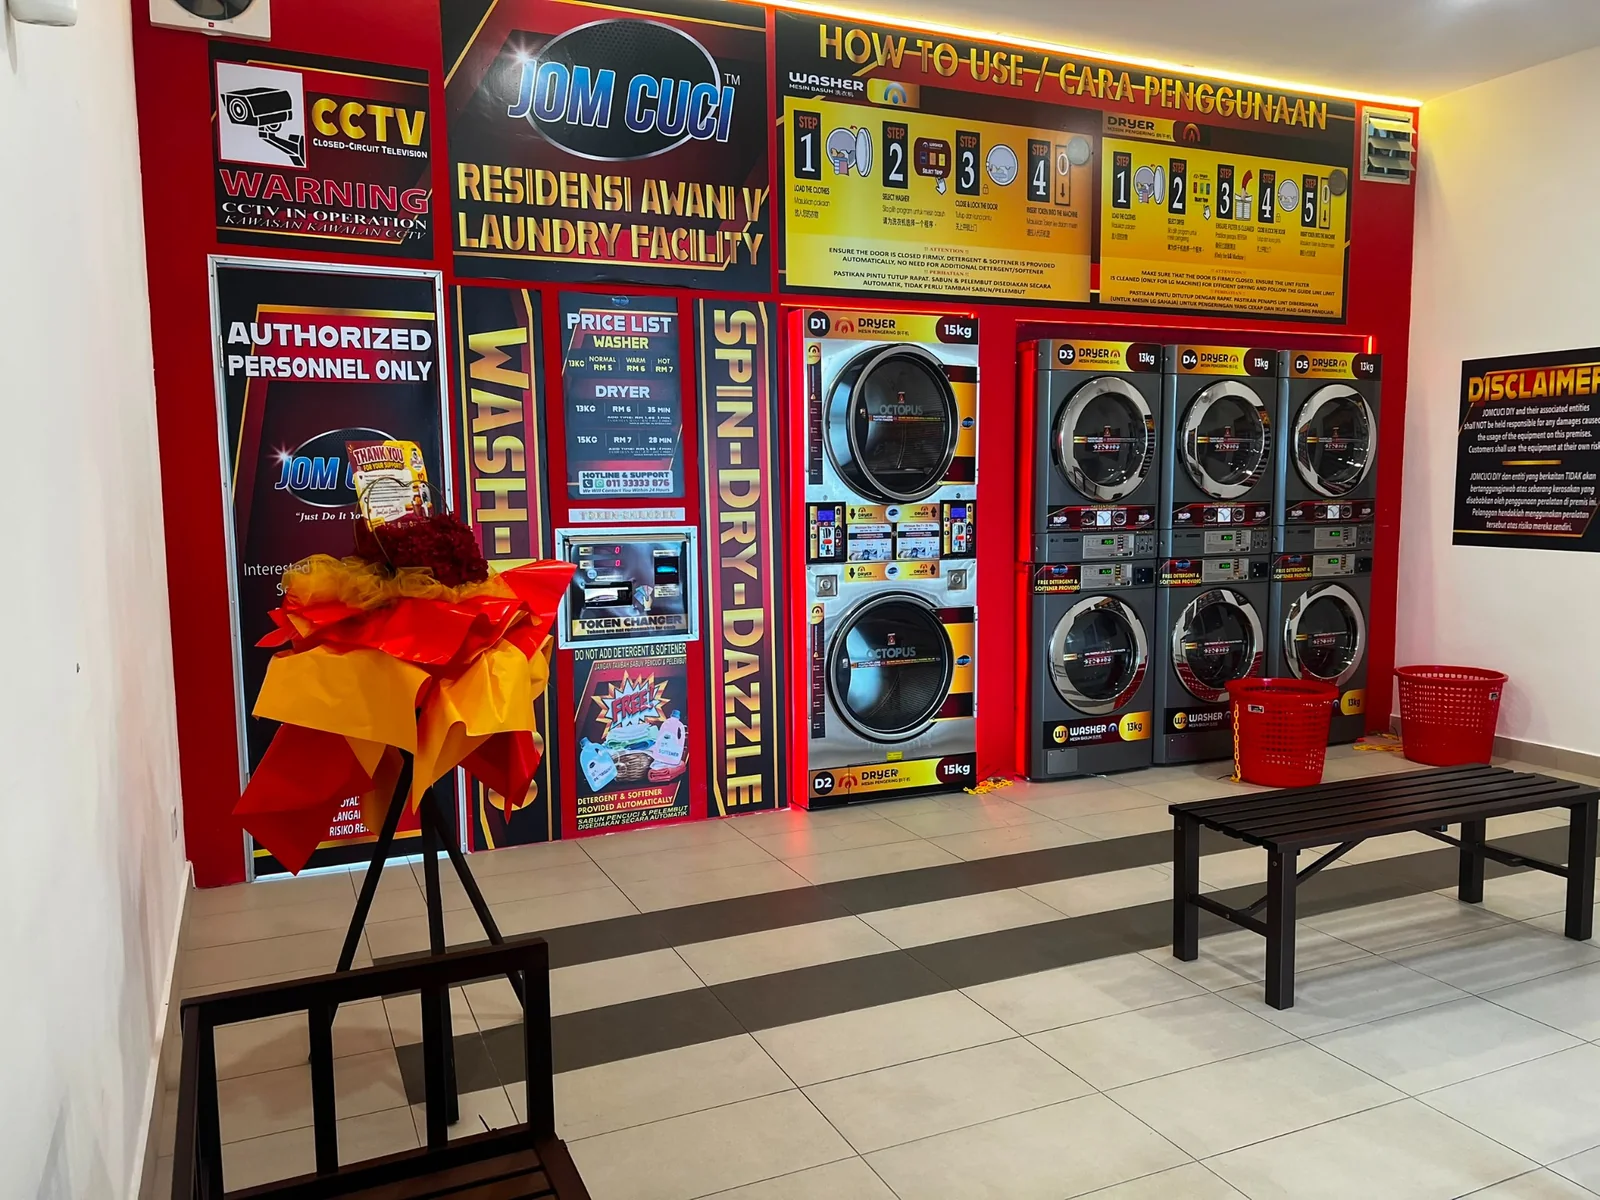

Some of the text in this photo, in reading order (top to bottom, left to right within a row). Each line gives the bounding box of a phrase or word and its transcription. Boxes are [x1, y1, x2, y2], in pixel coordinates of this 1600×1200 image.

[724, 73, 741, 86] TM
[789, 71, 864, 91] WASHER
[820, 24, 1327, 130] HOW TO USE / CARA PENGGUNAAN
[789, 83, 810, 91] MESIN
[508, 60, 735, 142] JOM CUCI
[312, 98, 426, 145] CCTV
[799, 116, 818, 130] STEP
[1107, 115, 1155, 131] DRYER
[887, 126, 905, 140] STEP
[960, 135, 977, 149] STEP
[801, 133, 816, 173] 1
[1032, 143, 1049, 156] STEP
[889, 142, 904, 182] 2
[1116, 155, 1130, 168] STEP
[1172, 162, 1184, 173] STEP
[961, 151, 975, 189] 3
[1220, 168, 1232, 179] STEP
[1033, 159, 1047, 196] 4
[1262, 173, 1274, 184] STEP
[1305, 178, 1317, 189] STEP
[219, 169, 429, 214] WARNING
[457, 162, 762, 222] RESIDENSI AWANI V
[1117, 170, 1127, 204] 1
[1172, 176, 1183, 210] 2
[1220, 182, 1230, 214] 3
[1261, 187, 1272, 218] 4
[1304, 191, 1314, 223] 5
[222, 202, 427, 230] CCTV IN OPERATION
[225, 215, 426, 240] KAWASAN KAWALAN CCTV
[458, 212, 764, 266] LAUNDRY FACILITY
[842, 256, 896, 266] AUTOMATICALLY,
[940, 263, 978, 271] ADDITIONAL
[979, 265, 1044, 275] DETERGENT/SOFTENER
[989, 258, 1018, 266] SOFTENER
[1027, 261, 1056, 269] PROVIDED
[567, 313, 671, 333] PRICE LIST
[810, 317, 826, 329] D1
[858, 317, 896, 329] DRYER
[227, 321, 432, 351] AUTHORIZED
[944, 324, 972, 338] 15kg
[593, 335, 649, 349] WASHER
[1059, 349, 1074, 359] D3
[1079, 348, 1109, 358] DRYER
[1138, 352, 1155, 365] 13kg
[1182, 354, 1197, 364] D4
[1201, 353, 1228, 363] DRYER
[228, 355, 432, 381] PERSONNEL ONLY
[1254, 358, 1269, 370] 13kg
[1296, 360, 1309, 370] D5
[1312, 358, 1338, 368] DRYER
[1360, 362, 1374, 373] 13kg
[595, 385, 650, 398] DRYER
[576, 405, 596, 413] 13KG
[879, 404, 923, 416] OCTOPUS
[1506, 407, 1515, 416] DIY
[1516, 407, 1526, 415] and
[1527, 405, 1539, 414] their
[1540, 404, 1568, 414] associated
[1569, 403, 1590, 412] entities
[577, 436, 598, 444] 15KG
[613, 436, 626, 444] RM
[627, 436, 632, 444] 7
[353, 446, 404, 465] THANK YOU
[275, 456, 340, 491] JOM
[630, 471, 669, 479] SUPPORT
[623, 479, 650, 487] 33333
[652, 479, 670, 487] 876
[322, 512, 335, 521] Do
[338, 512, 347, 521] It
[713, 309, 763, 806] SPIN-DRY-DAZZLE
[579, 615, 682, 629] TOKEN CHANGER
[575, 643, 687, 661] DO NOT ADD DETERGENT & SOFTENER
[866, 646, 917, 659] OCTOPUS
[612, 686, 655, 722] FREE!
[1347, 698, 1361, 708] 13kg
[1174, 716, 1187, 725] W2
[1188, 712, 1223, 723] WASHER
[1070, 725, 1107, 736] WASHER
[1127, 722, 1143, 733] 13kg
[1054, 730, 1067, 739] W1
[861, 768, 898, 780] DRYER
[943, 763, 971, 777] 15kg
[814, 777, 832, 789] D2
[577, 793, 619, 806] DETERGENT
[628, 788, 662, 799] SOFTENER
[577, 796, 674, 814] PROVIDED AUTOMATICALLY
